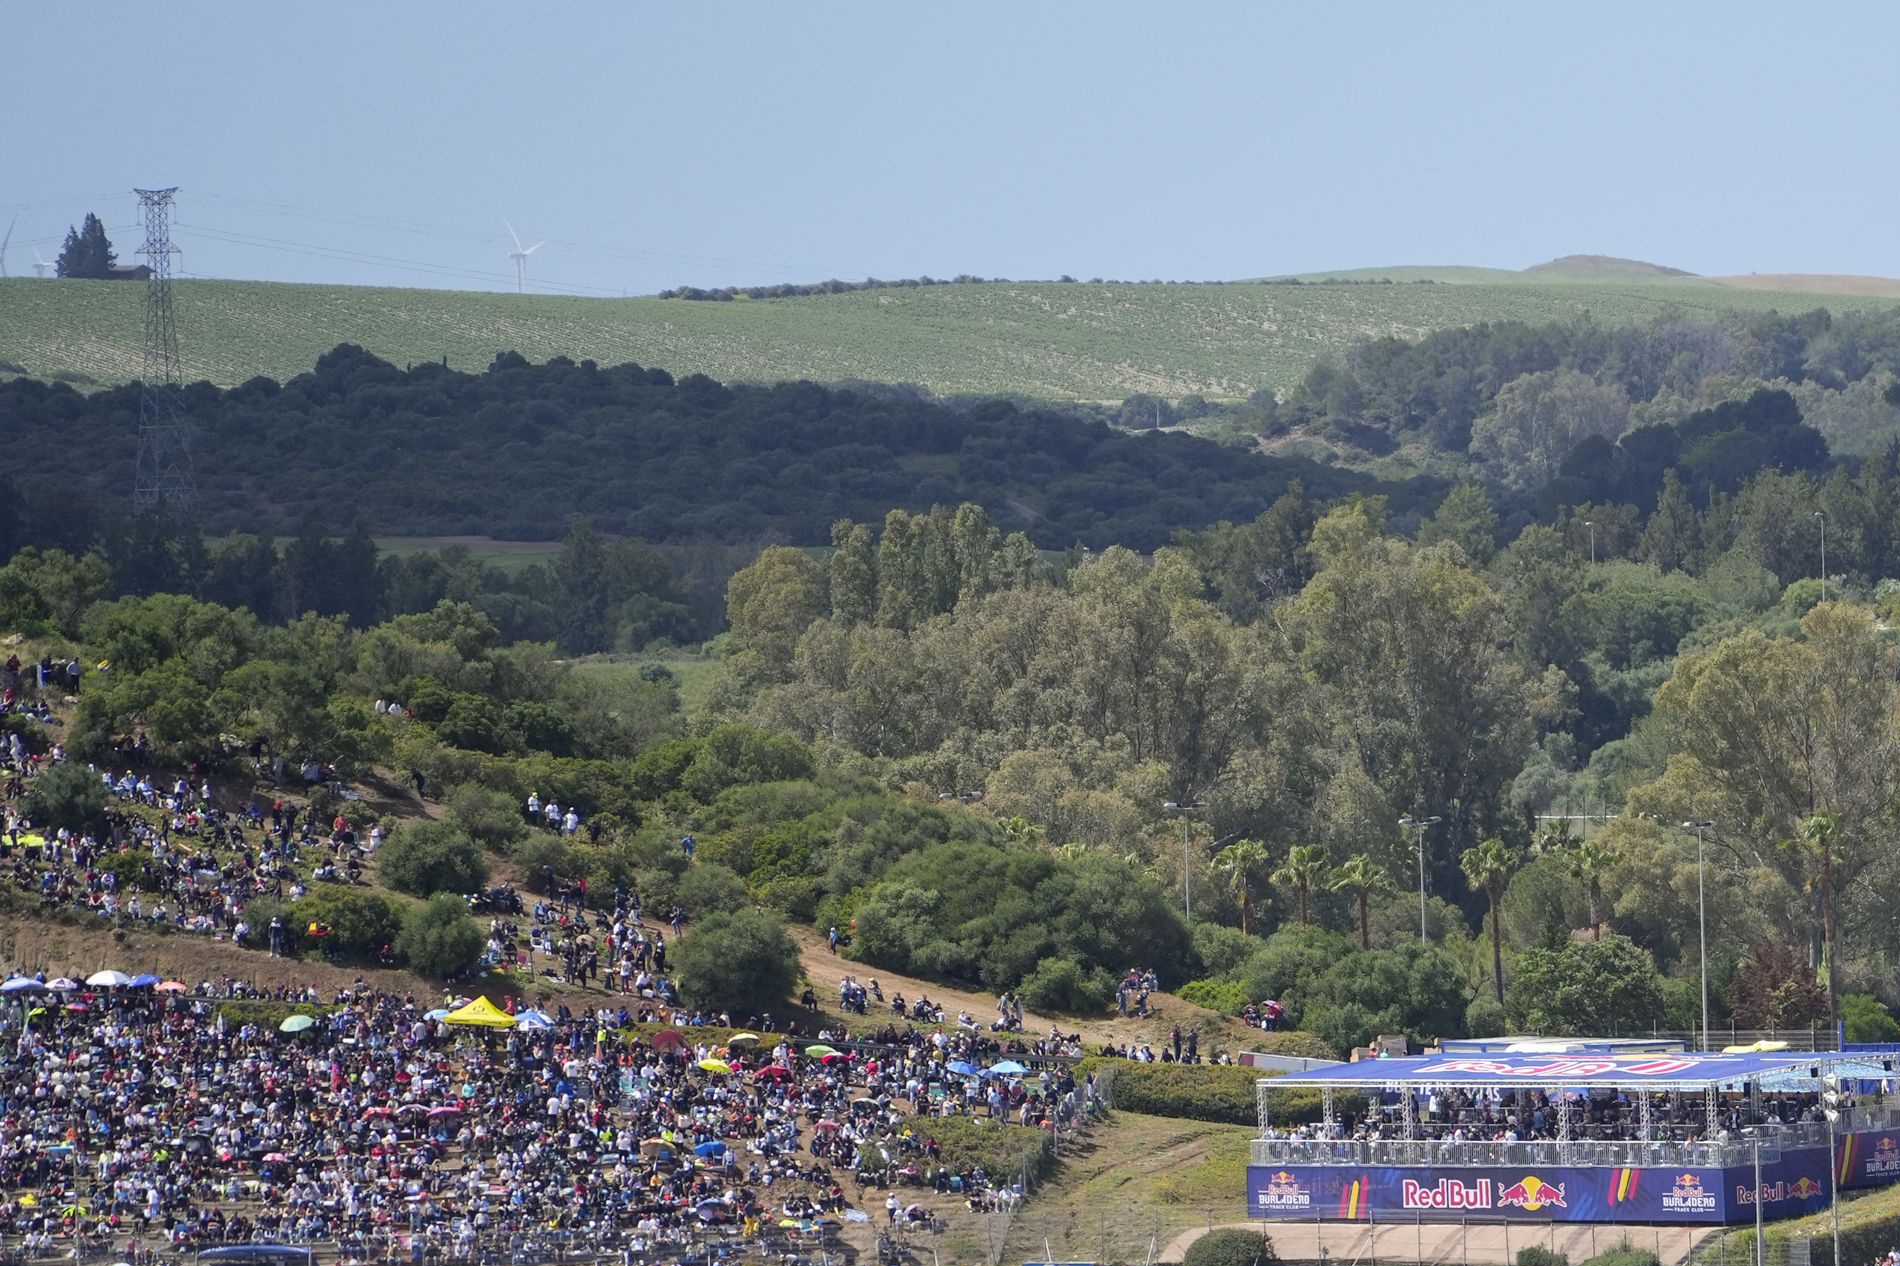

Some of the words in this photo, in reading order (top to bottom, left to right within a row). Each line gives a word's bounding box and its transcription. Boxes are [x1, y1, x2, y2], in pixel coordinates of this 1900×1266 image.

[1269, 1184, 1284, 1194] Red
[1283, 1184, 1299, 1194] Bull
[1403, 1178, 1447, 1209] Red
[1448, 1178, 1491, 1209] Bull
[1673, 1186, 1688, 1197] Red
[1688, 1186, 1704, 1197] Bull
[1762, 1181, 1783, 1200] Bull
[1258, 1195, 1310, 1205] BURLADERO
[1663, 1198, 1715, 1207] BURLADERO
